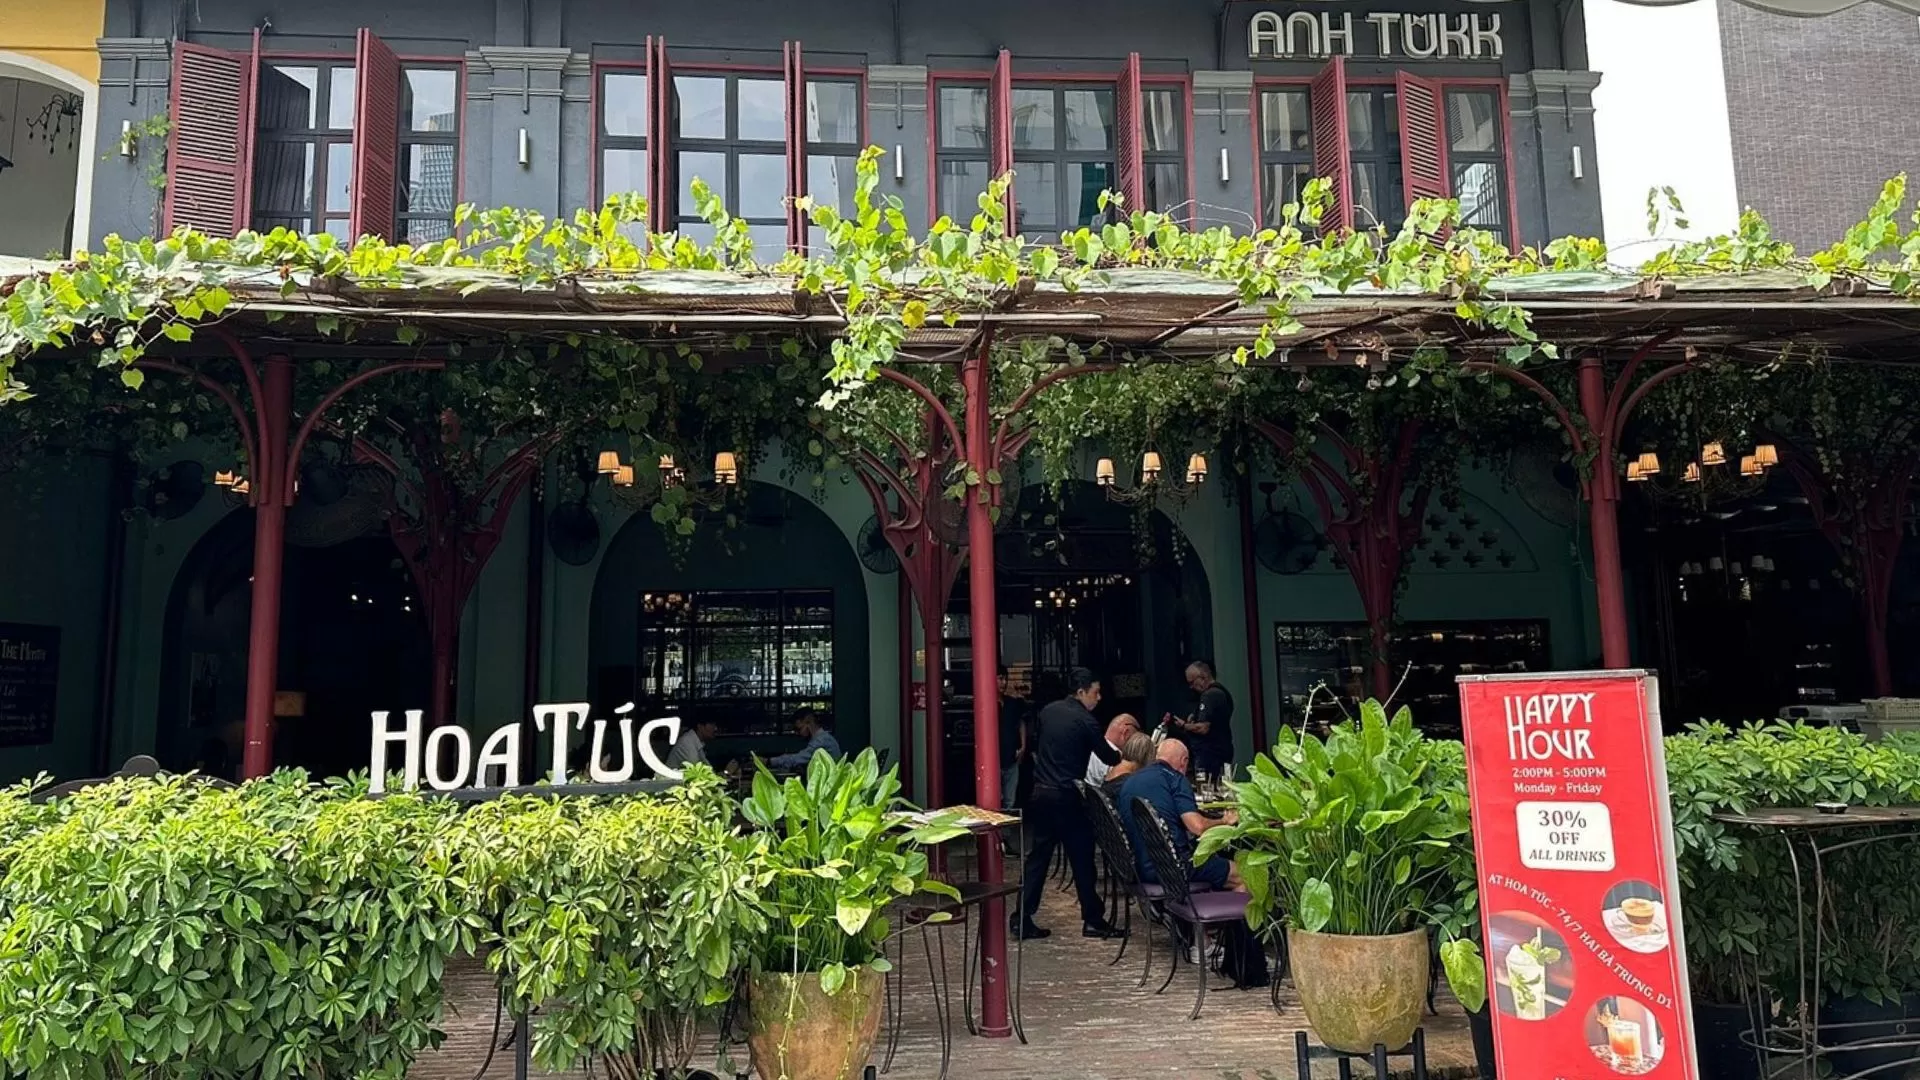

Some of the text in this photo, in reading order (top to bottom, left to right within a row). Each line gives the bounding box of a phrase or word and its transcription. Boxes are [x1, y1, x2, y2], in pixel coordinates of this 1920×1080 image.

[1249, 11, 1354, 58] ANH
[1503, 692, 1596, 726] HAPPY
[368, 702, 684, 793] HOA TÚC
[1504, 728, 1595, 760] HOUR
[1512, 767, 1554, 778] 2:00PM
[1562, 767, 1606, 778] 5:00PM
[1513, 782, 1557, 796] Monday
[1566, 782, 1603, 796] Friday
[1538, 809, 1587, 829] 30%
[1549, 831, 1581, 846] OFF
[1529, 848, 1607, 863] ALL DRINKS
[1488, 873, 1504, 885] AT
[1504, 877, 1529, 896] HOA
[1557, 907, 1584, 933] 74/7
[1580, 931, 1602, 953] HAI
[1655, 992, 1673, 1010] D1
